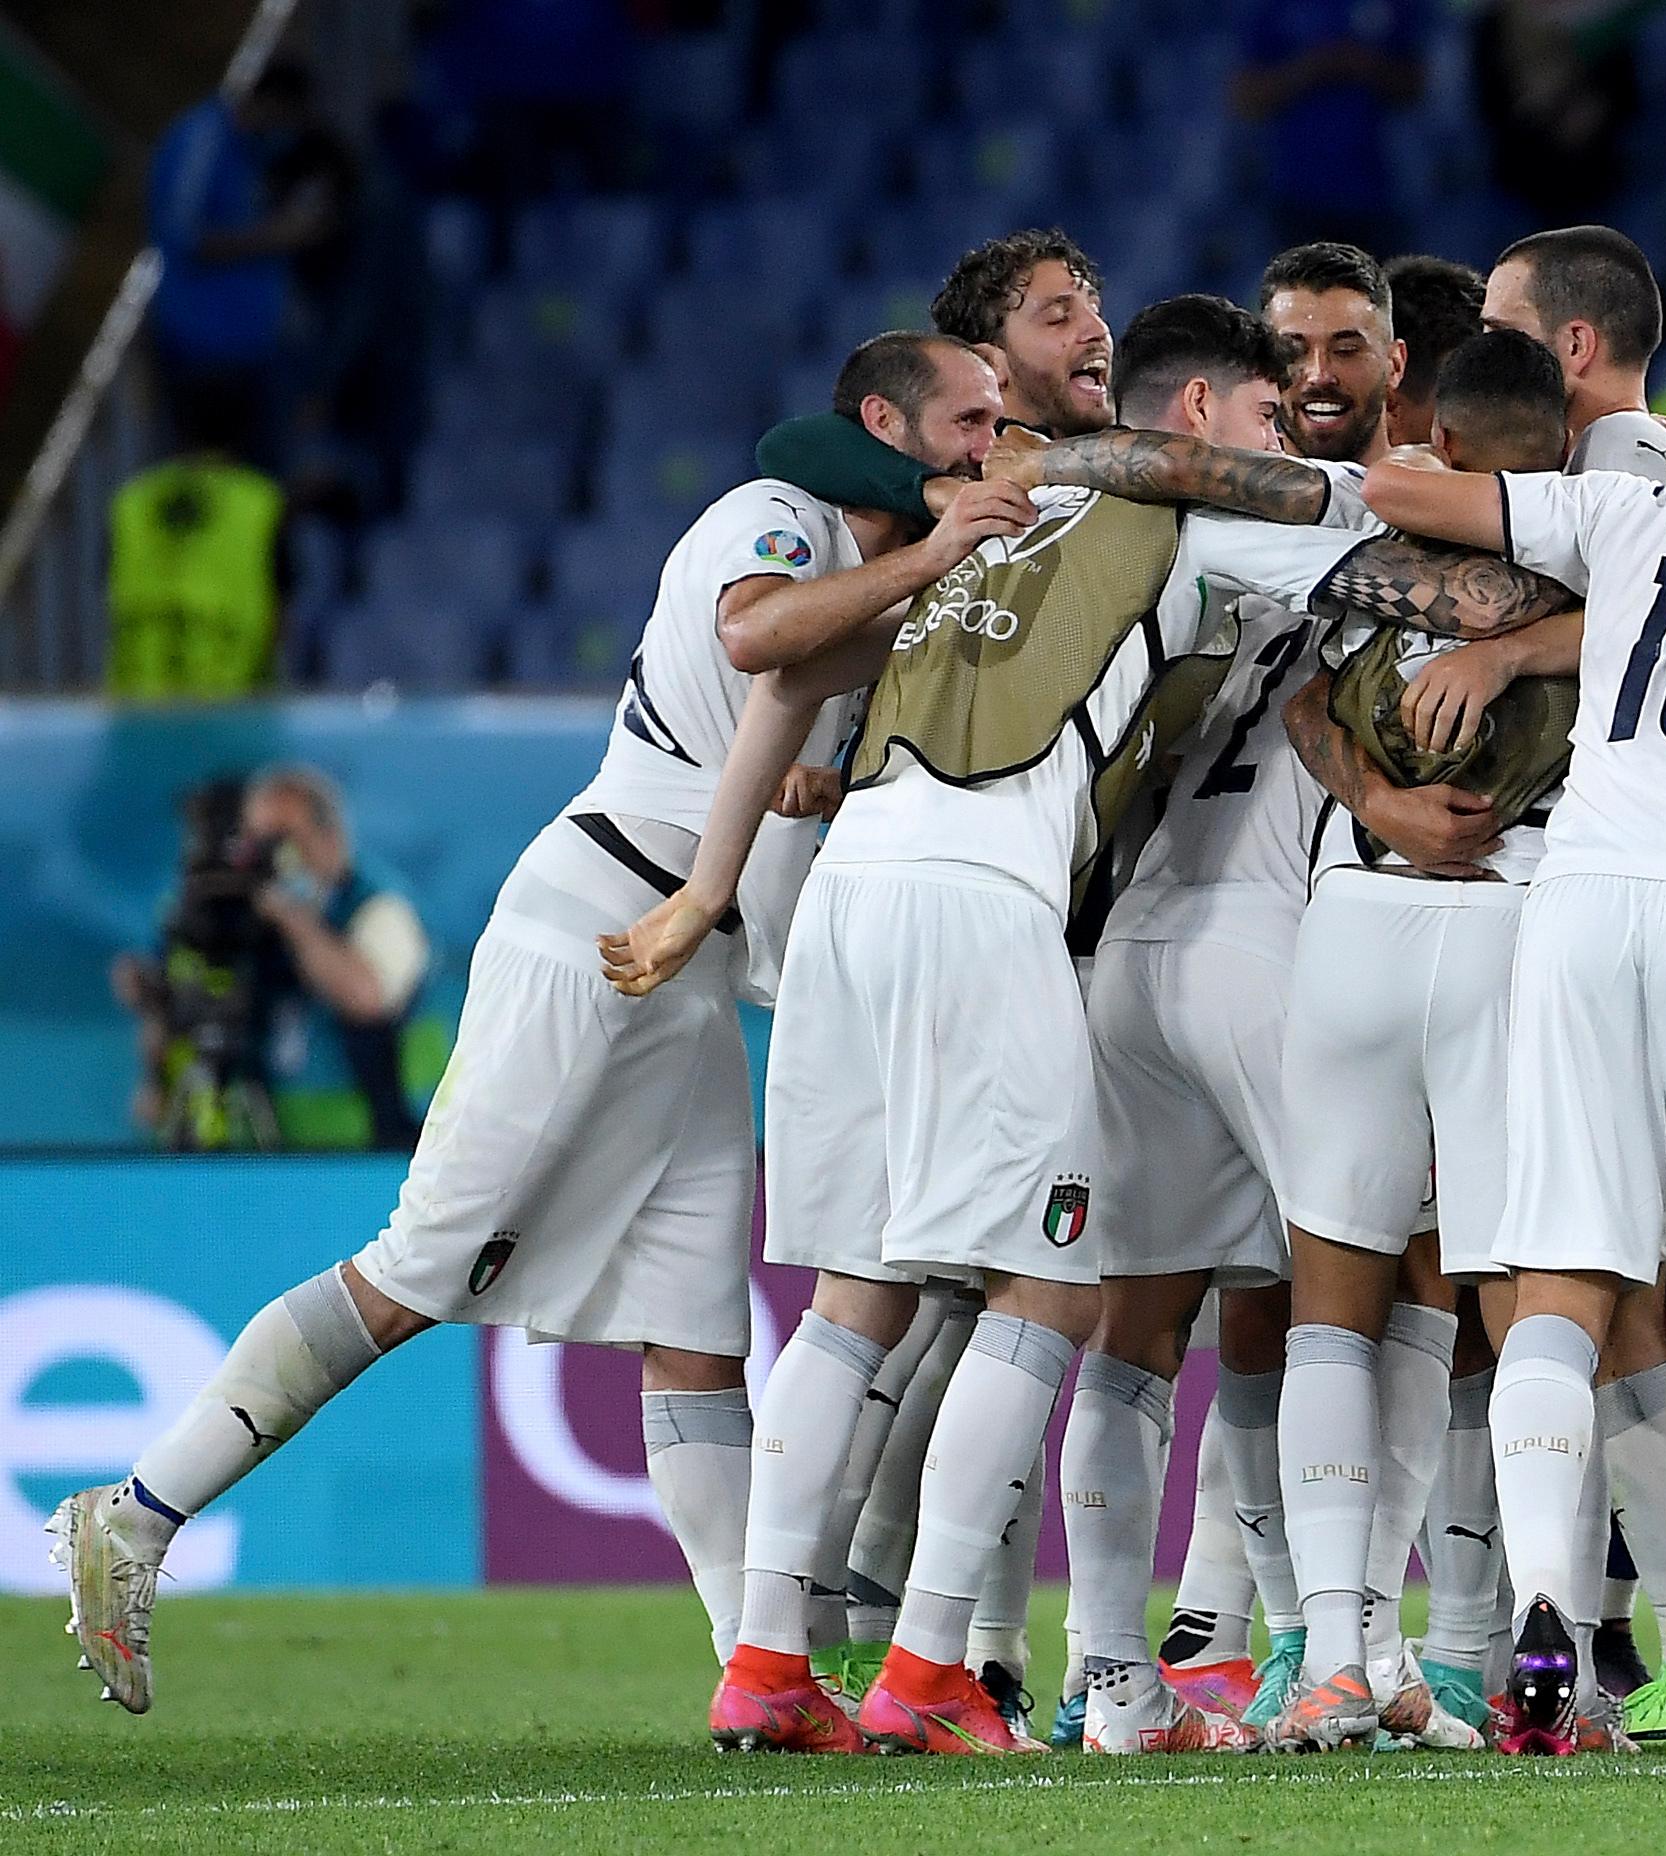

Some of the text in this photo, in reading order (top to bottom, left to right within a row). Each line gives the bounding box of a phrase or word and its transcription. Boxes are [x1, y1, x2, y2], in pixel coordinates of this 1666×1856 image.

[1192, 618, 1269, 800] 2
[1502, 1436, 1569, 1458] ITALIA
[1301, 1463, 1369, 1484] ITALIA
